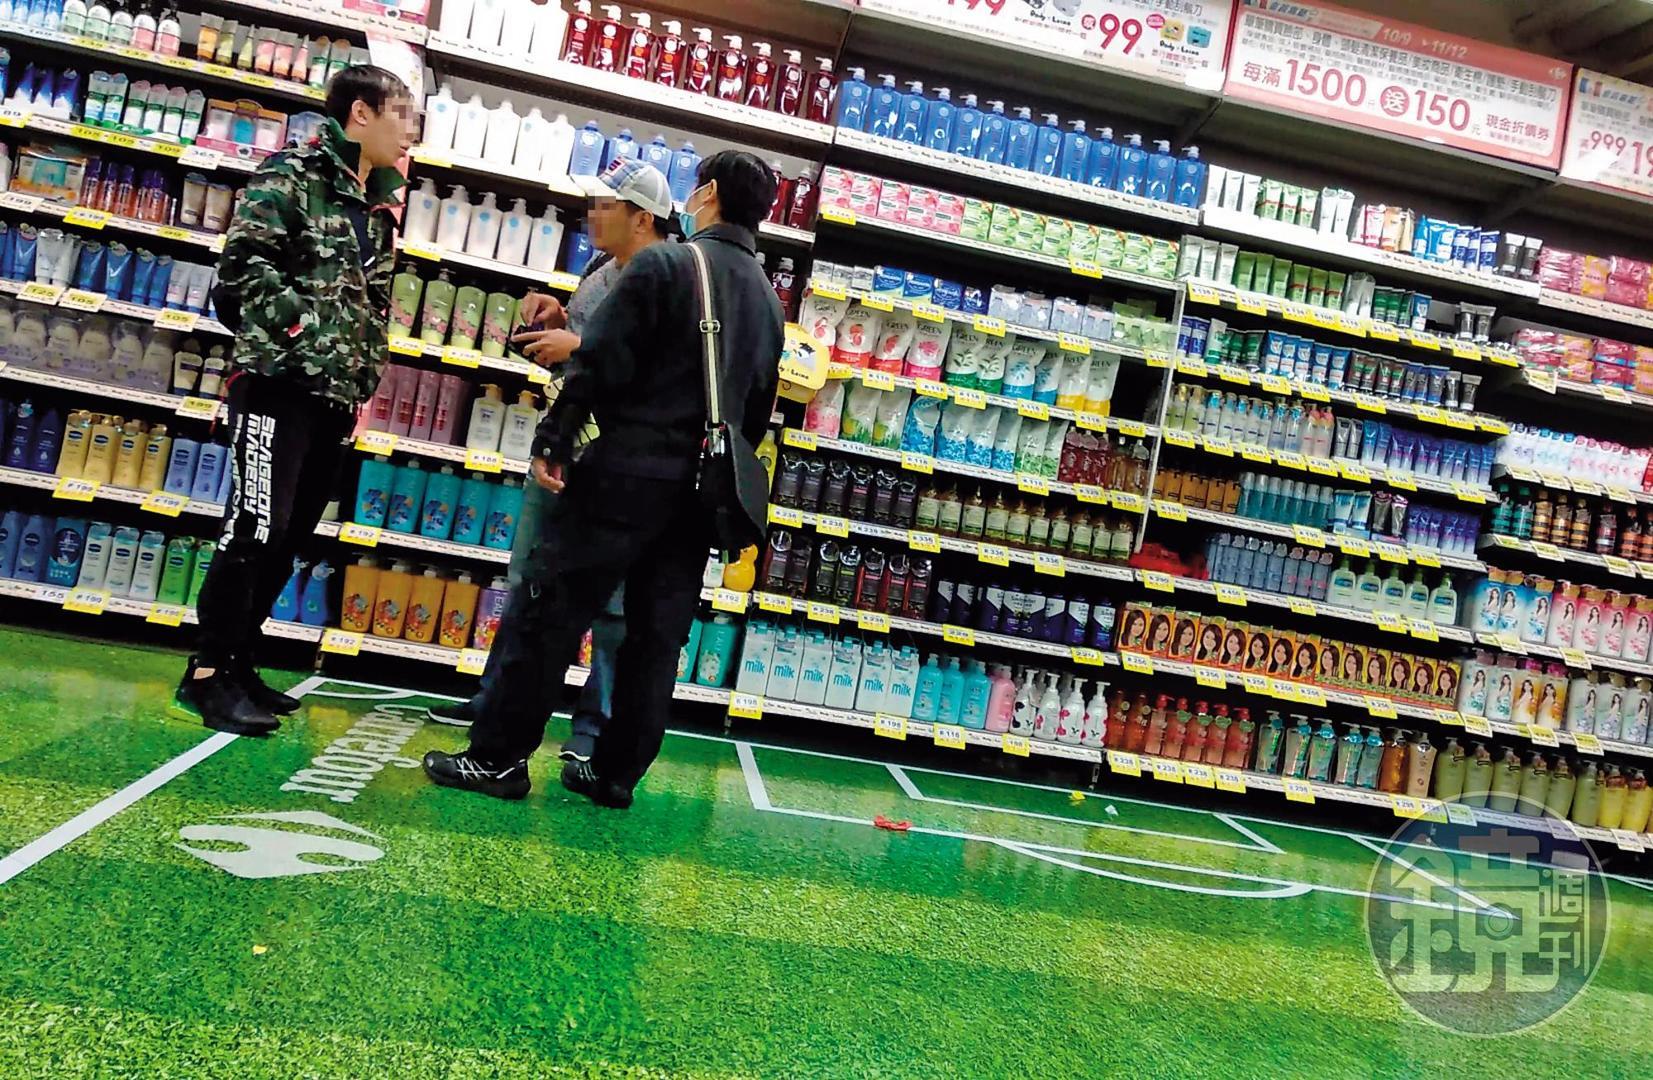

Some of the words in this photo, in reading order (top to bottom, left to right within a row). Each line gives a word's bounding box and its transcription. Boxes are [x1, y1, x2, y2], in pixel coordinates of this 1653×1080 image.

[1100, 13, 1142, 55] 99
[1383, 28, 1412, 45] 10/9
[1431, 40, 1468, 58] 11/12
[1243, 61, 1281, 88] 每滿
[1286, 59, 1366, 106] 1500
[1414, 90, 1471, 132] 150
[1591, 131, 1626, 156] 999
[745, 659, 765, 674] milk
[774, 664, 794, 679] milk
[803, 668, 824, 683] milk
[833, 673, 853, 688] milk
[864, 676, 884, 692] milk
[892, 681, 912, 697] milk
